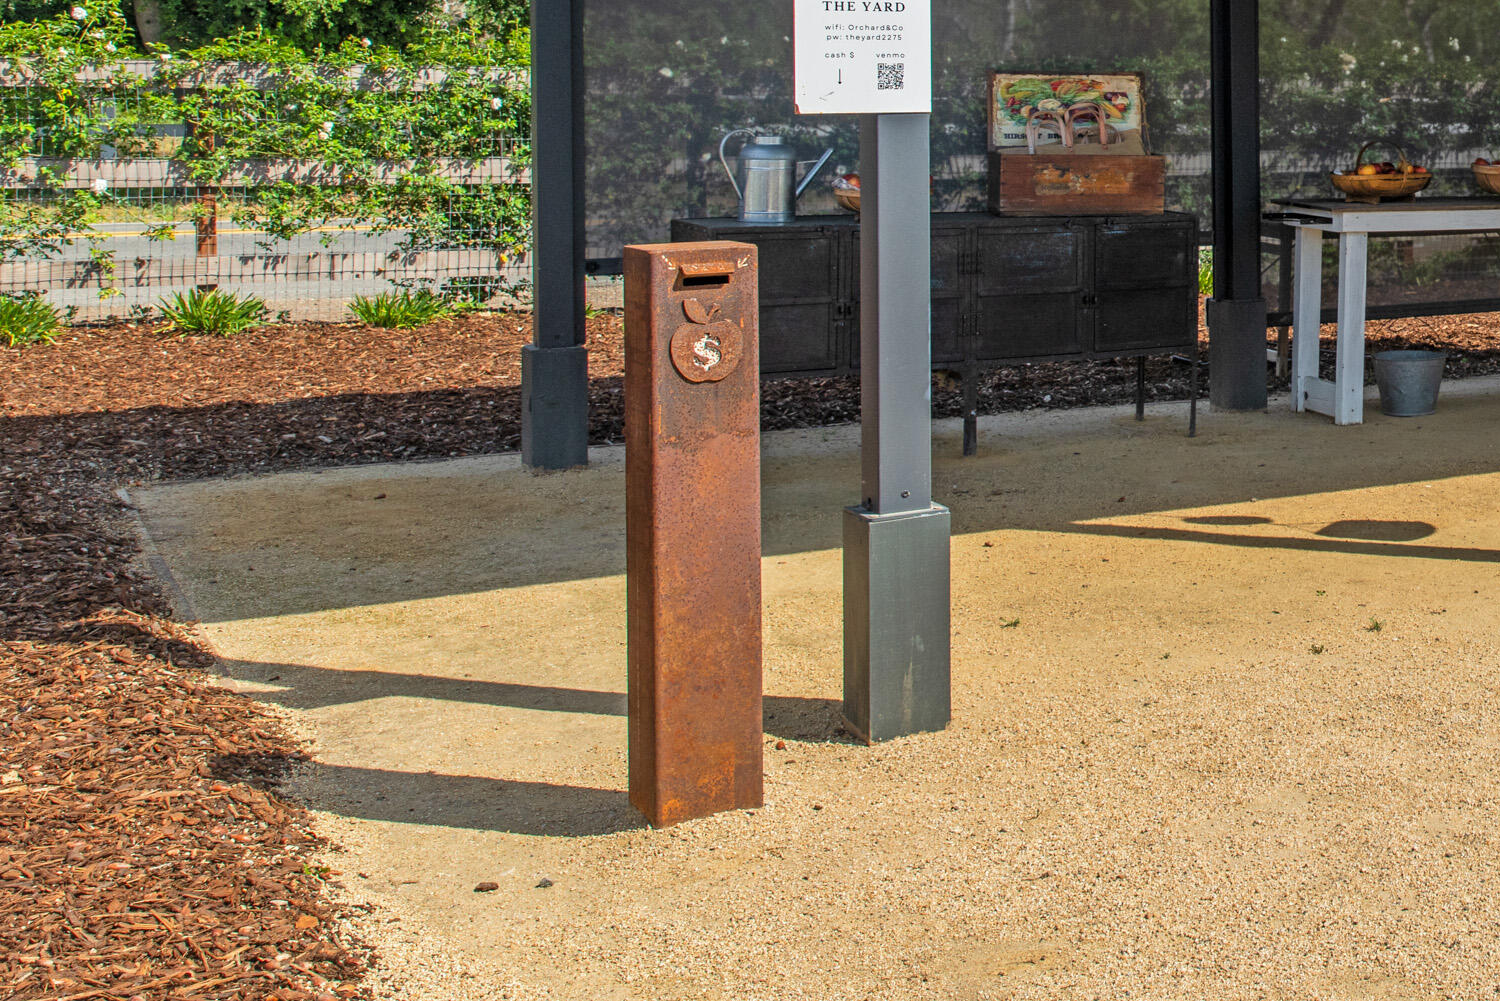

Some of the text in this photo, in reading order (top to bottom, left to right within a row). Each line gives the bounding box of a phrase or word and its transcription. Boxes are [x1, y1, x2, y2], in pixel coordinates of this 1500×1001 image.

[822, 1, 906, 13] THE YARD
[848, 24, 904, 32] Orchard&Co
[845, 34, 902, 42] theyard2275
